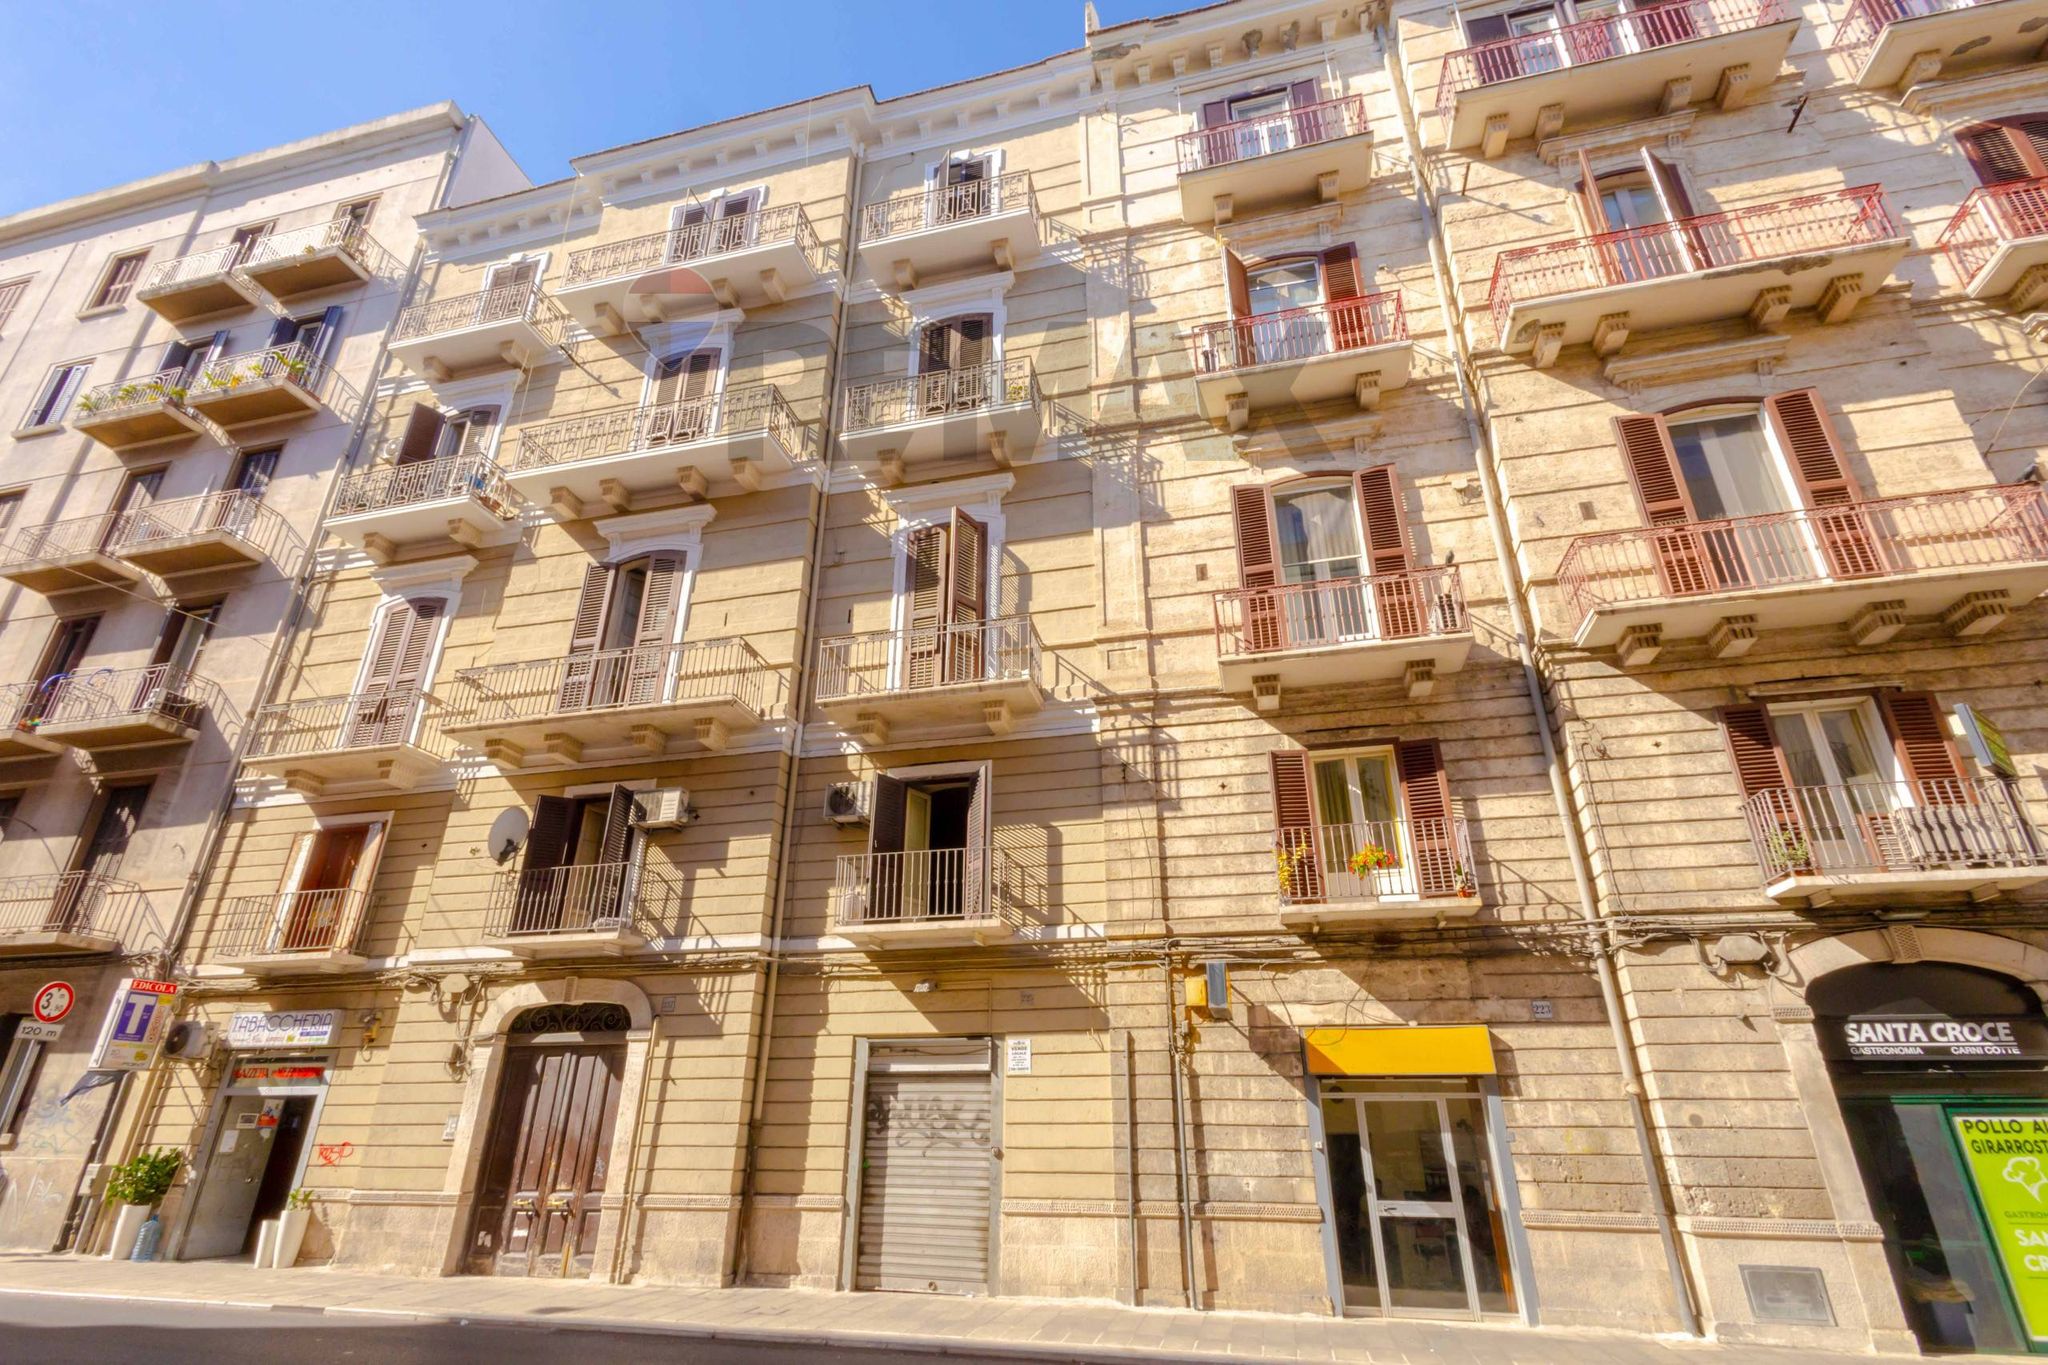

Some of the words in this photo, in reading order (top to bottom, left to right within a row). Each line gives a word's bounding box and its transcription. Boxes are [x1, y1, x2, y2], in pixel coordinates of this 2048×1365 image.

[132, 980, 175, 993] EDICOLA
[41, 992, 53, 1010] 3
[128, 994, 157, 1034] T
[1532, 1004, 1551, 1015] 223
[231, 1013, 333, 1033] TABACCHERIA
[21, 1026, 42, 1036] 120
[1844, 1022, 1929, 1043] SANTA
[1930, 1022, 2015, 1042] CROCE
[1850, 1046, 1924, 1056] GASTRONOMIA
[1950, 1046, 1984, 1055] CARNI
[1984, 1046, 2021, 1055] COTTE
[1963, 1119, 2023, 1134] POLLO
